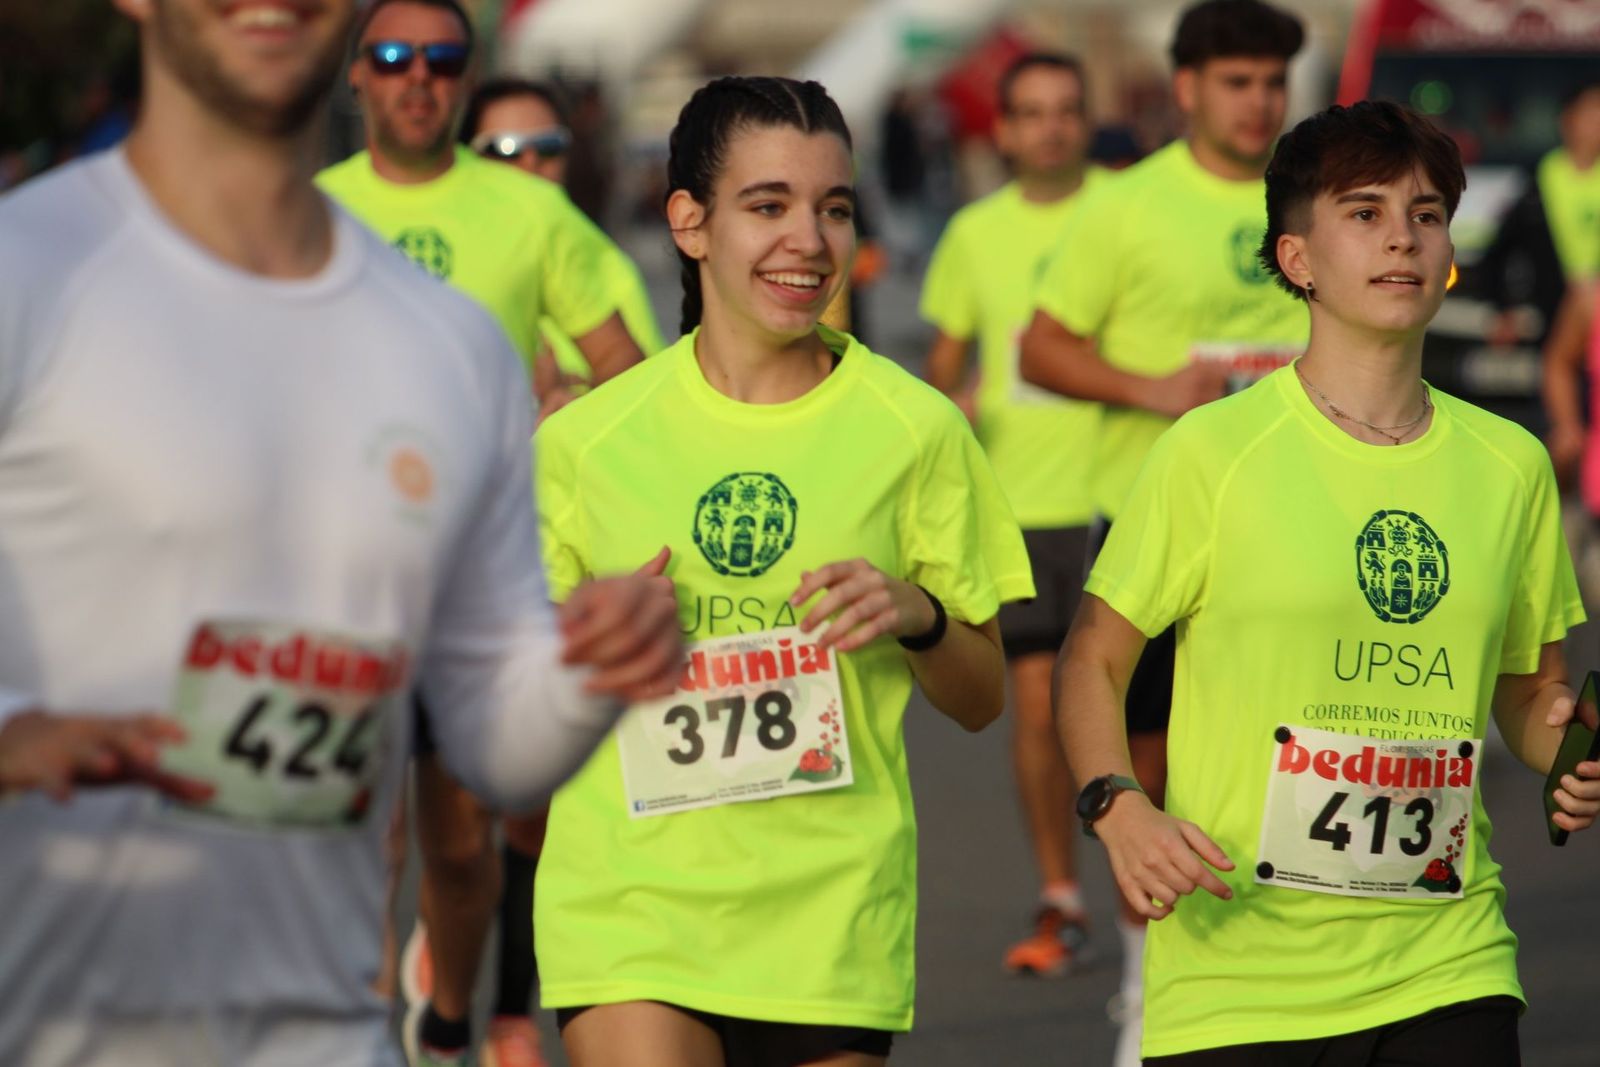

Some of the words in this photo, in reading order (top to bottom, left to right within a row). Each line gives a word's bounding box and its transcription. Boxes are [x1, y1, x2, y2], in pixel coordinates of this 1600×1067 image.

[680, 638, 831, 692] dunia
[1334, 638, 1455, 690] UPSA
[663, 690, 797, 766] 378
[1303, 703, 1401, 722] CORREMOS
[1404, 709, 1474, 734] JUNTOS
[1277, 735, 1474, 788] bedunia
[1308, 791, 1435, 857] 413
